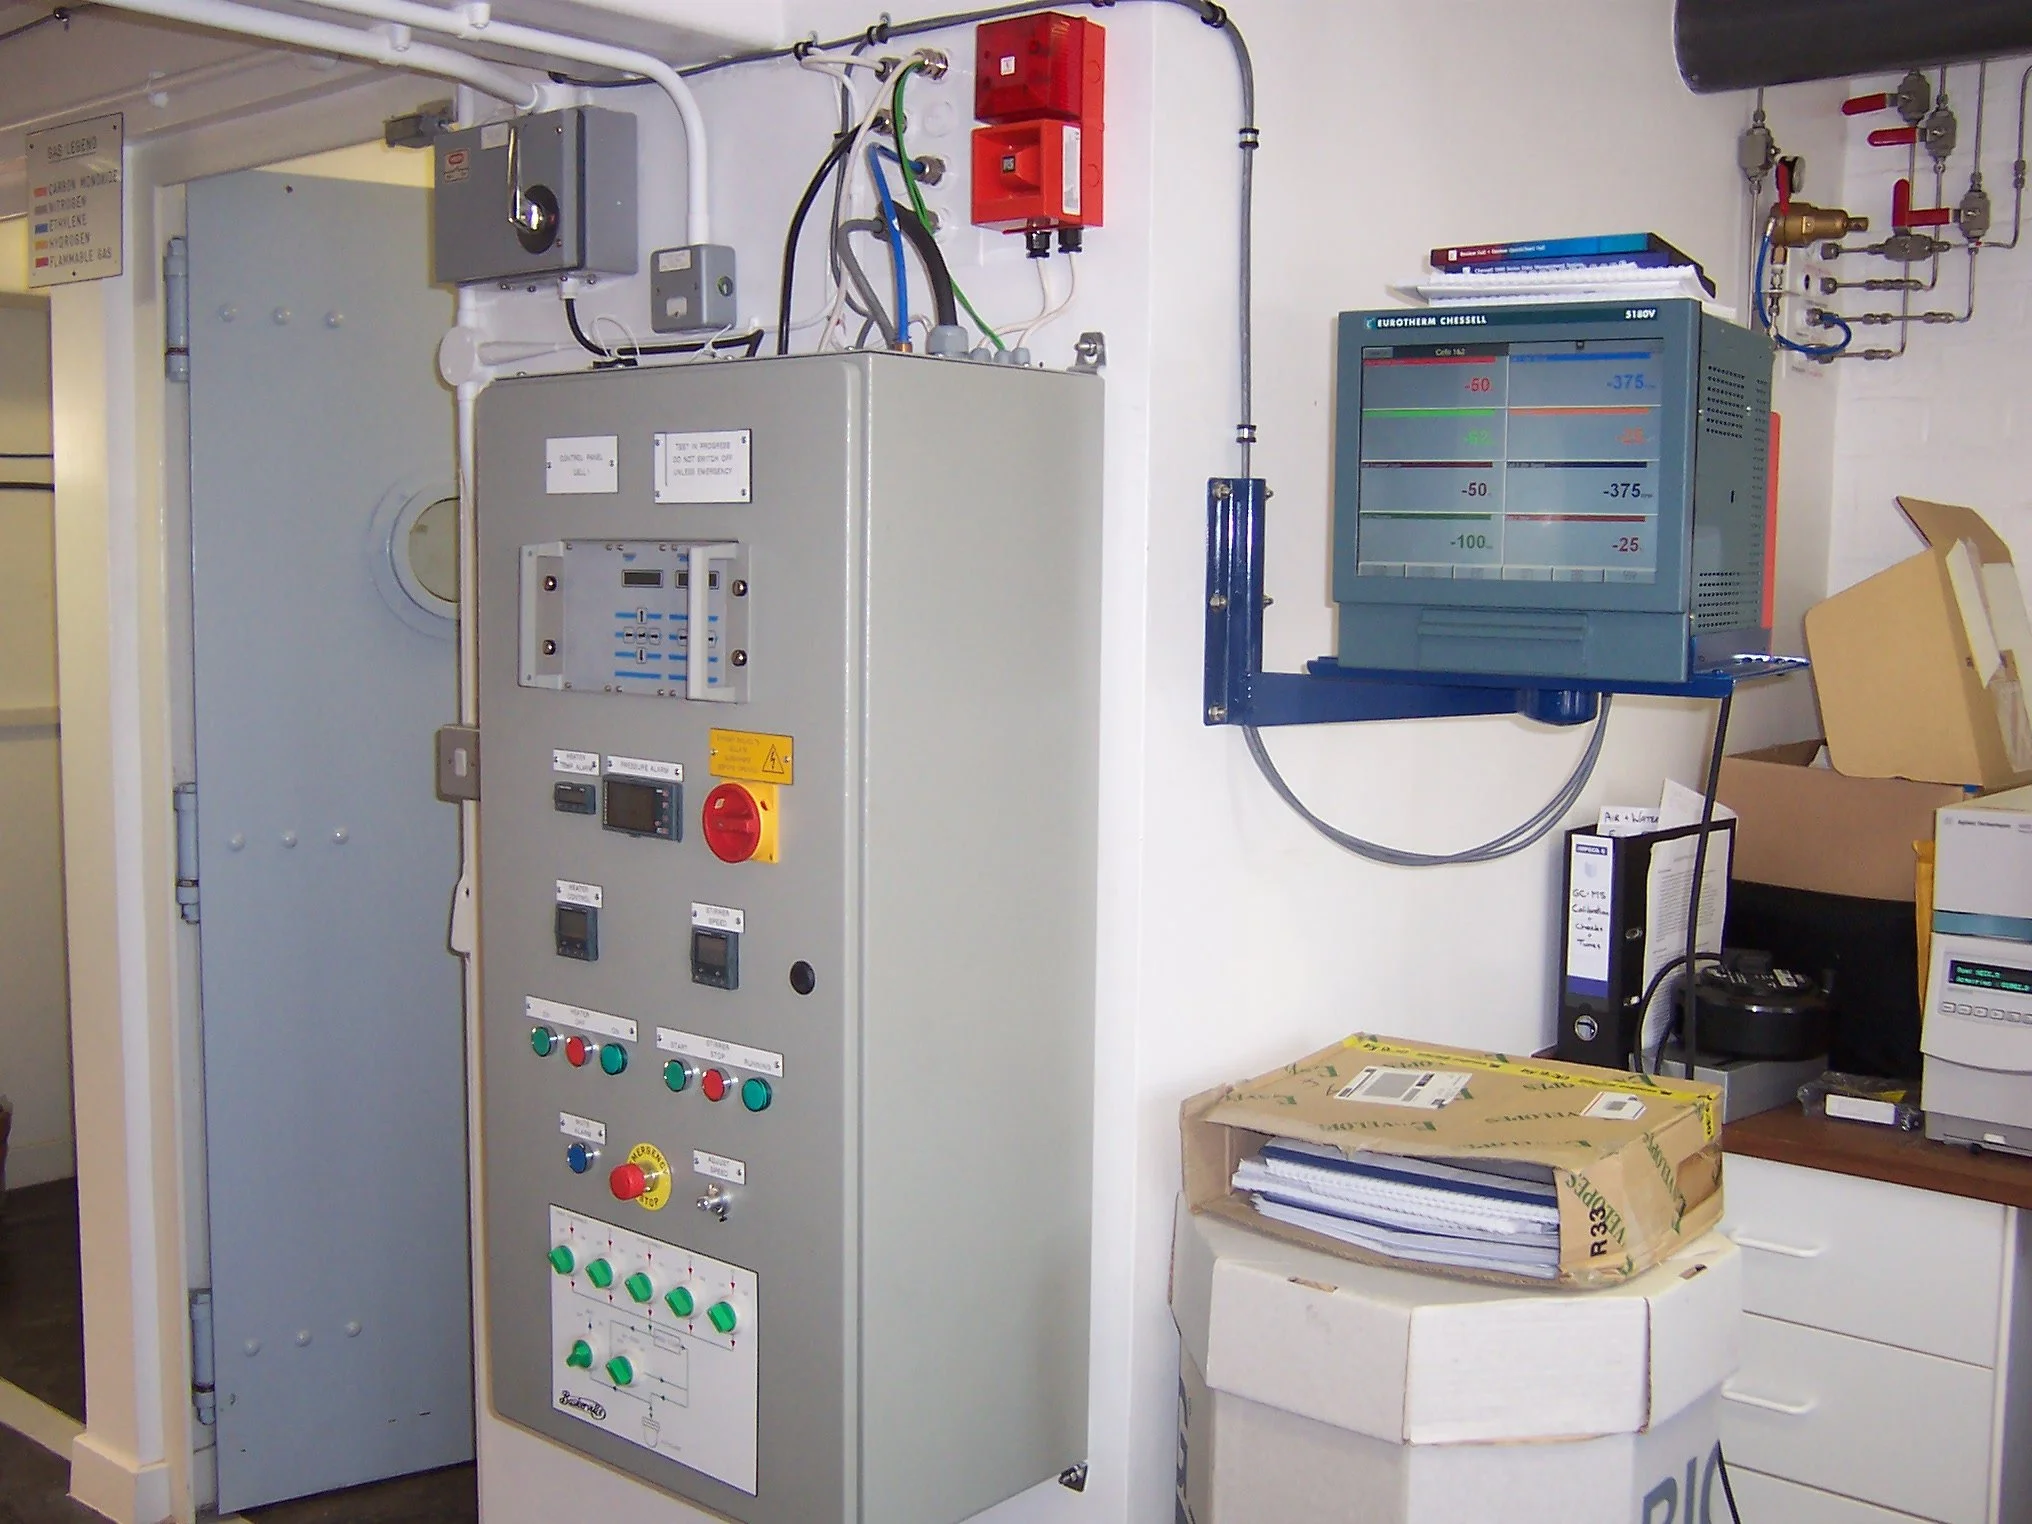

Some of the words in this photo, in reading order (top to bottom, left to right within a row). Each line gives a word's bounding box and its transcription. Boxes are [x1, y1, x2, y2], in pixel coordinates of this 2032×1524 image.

[1377, 317, 1436, 328] EUROTHERM
[1440, 315, 1487, 325] CHESSELL
[1625, 309, 1657, 319] 5180V
[1464, 377, 1490, 392] -50
[1607, 373, 1644, 389] -375
[1461, 482, 1488, 496] -50
[1603, 483, 1641, 498] -375
[1450, 534, 1486, 549] -100
[1612, 537, 1639, 552] -25
